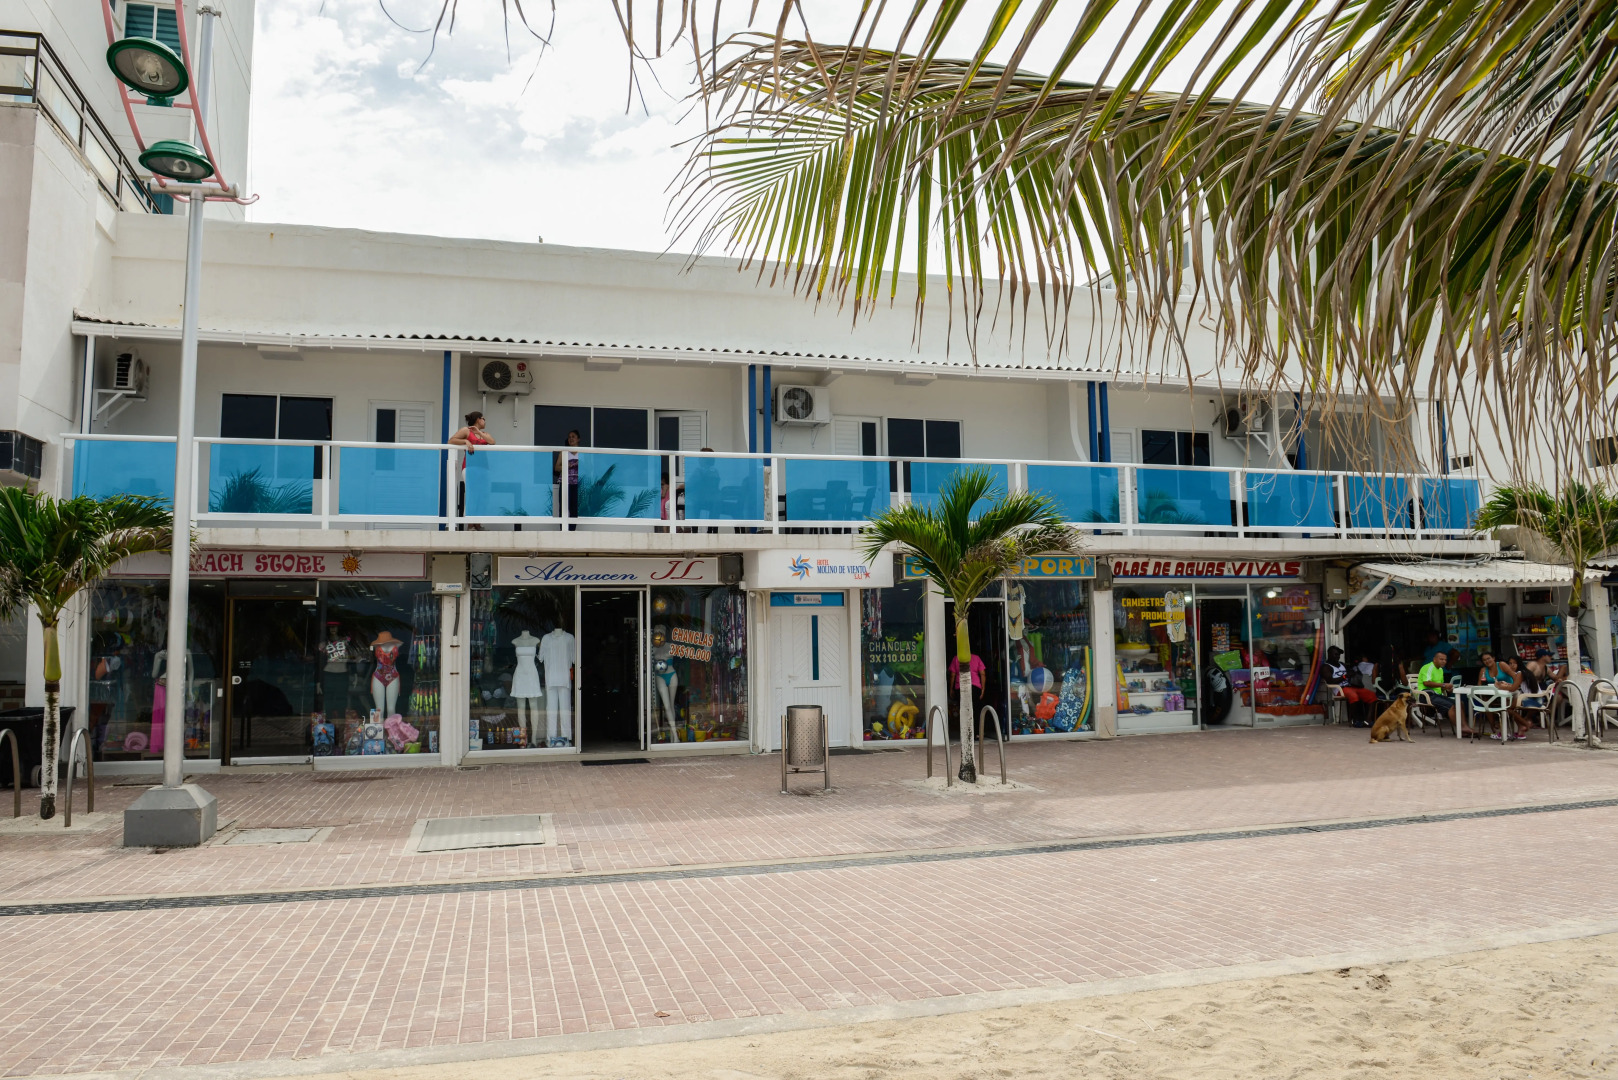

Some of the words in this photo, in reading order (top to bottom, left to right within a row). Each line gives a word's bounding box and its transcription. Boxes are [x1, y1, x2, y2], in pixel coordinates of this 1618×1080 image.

[255, 554, 326, 573] STORE
[514, 560, 638, 581] Almacen
[816, 565, 838, 574] MOLINO
[838, 565, 846, 574] DE
[846, 565, 867, 574] VIENTO
[1113, 561, 1149, 576] OLAS
[1152, 561, 1172, 576] DE
[1174, 561, 1226, 576] AGUAS
[1231, 561, 1301, 576] VIVAS
[1121, 597, 1166, 607] CAMISETAS
[1140, 611, 1186, 621] PROMOCION
[671, 627, 714, 647] CHANCLAS
[669, 643, 711, 662] 3X$10.000
[869, 641, 917, 652] CHANCLAS
